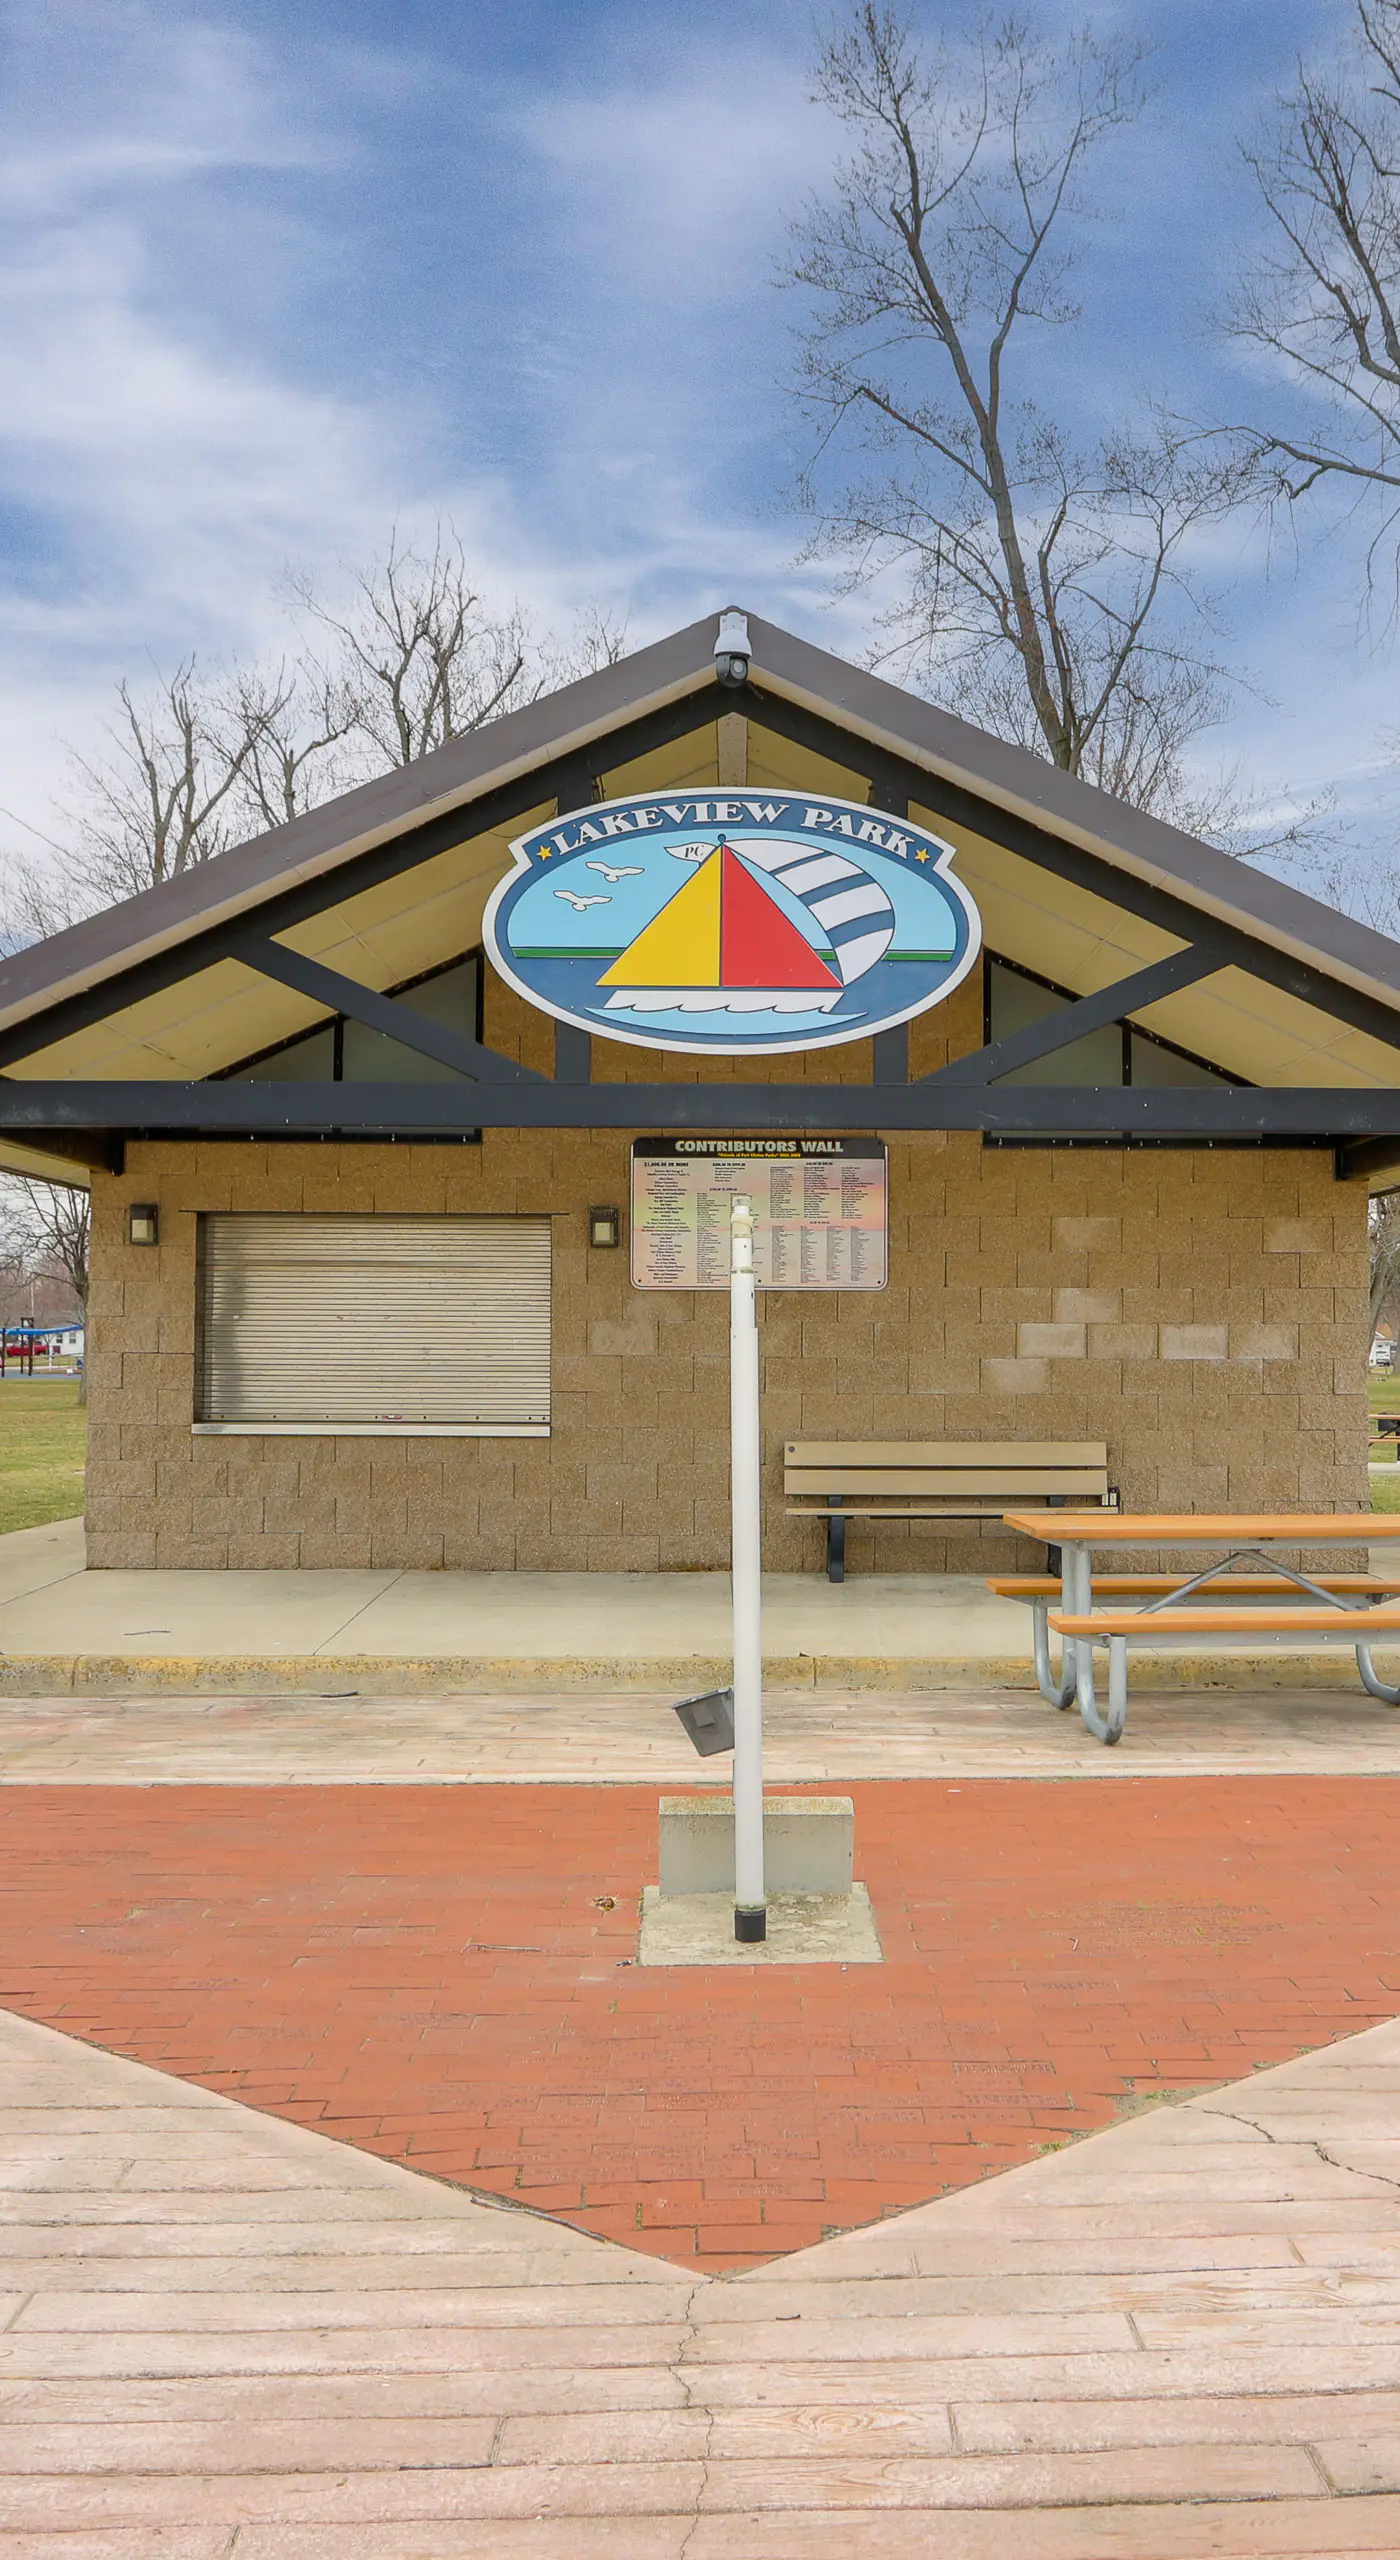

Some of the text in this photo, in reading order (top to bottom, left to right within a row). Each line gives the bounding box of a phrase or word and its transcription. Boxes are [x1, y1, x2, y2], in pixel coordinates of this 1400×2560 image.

[550, 801, 915, 859] LAKEVIEW PARK
[684, 844, 705, 858] PC
[675, 1141, 844, 1152] CONTRIBUTORS WALL
